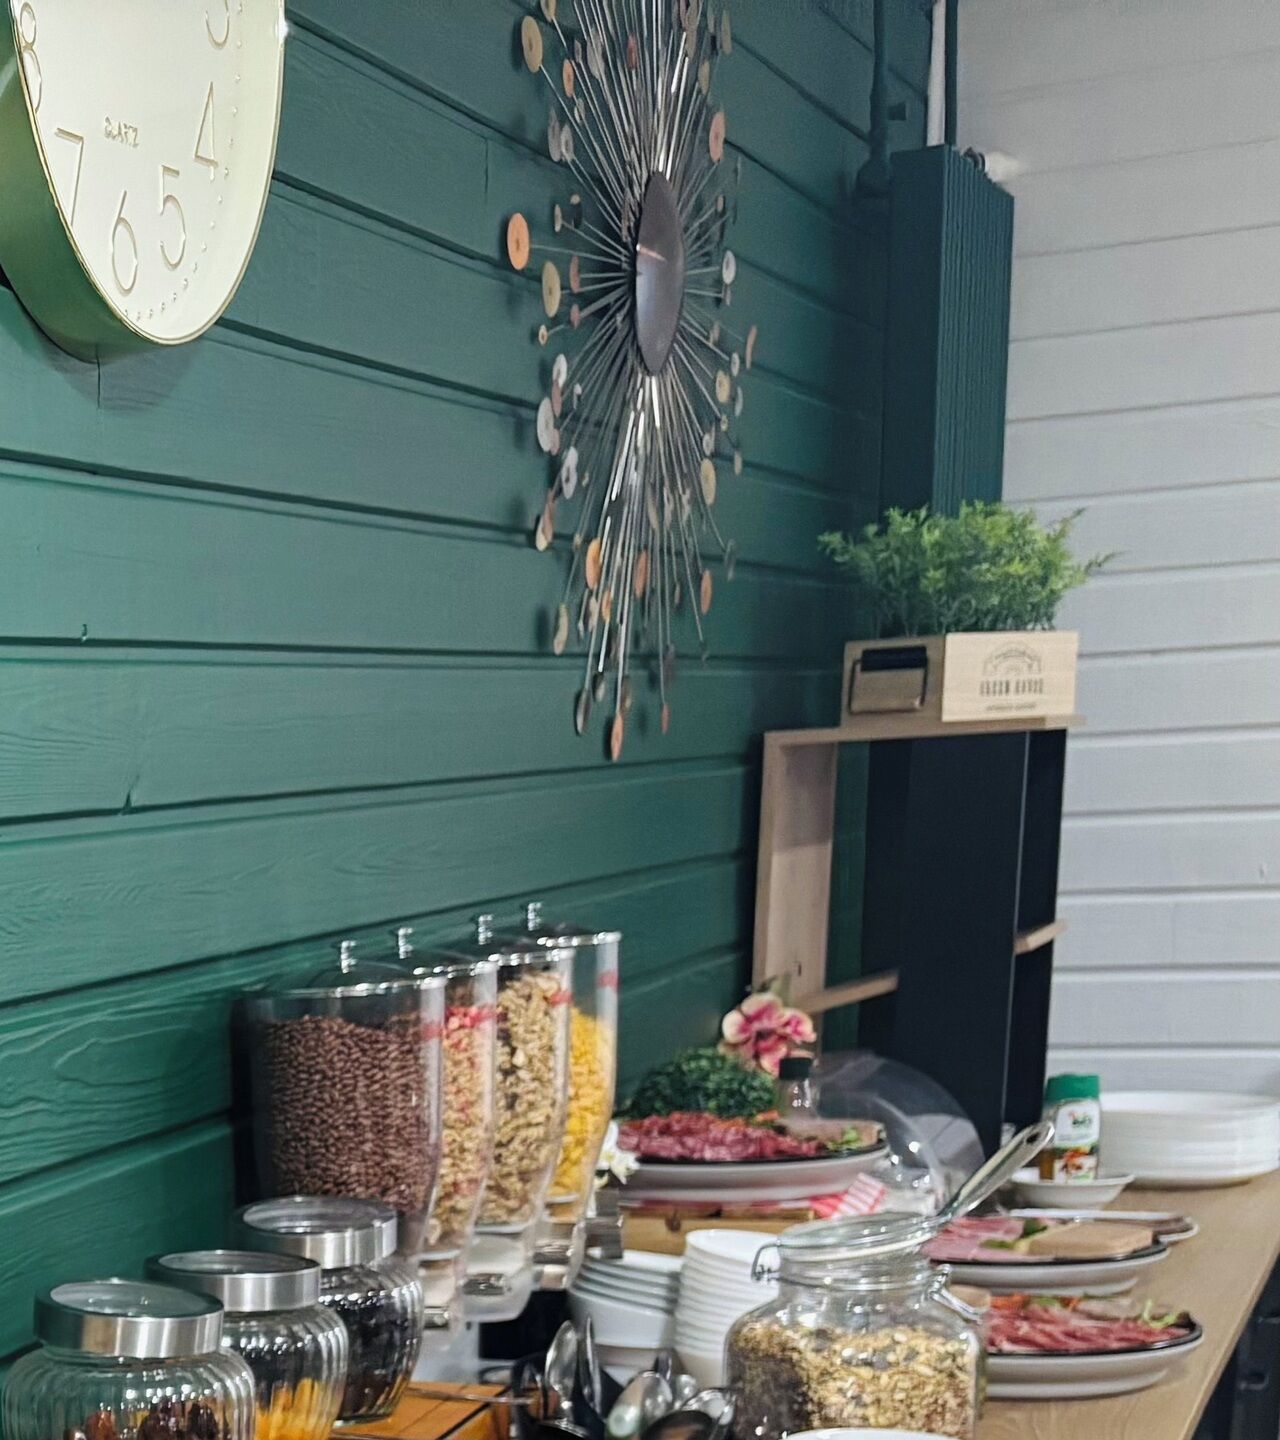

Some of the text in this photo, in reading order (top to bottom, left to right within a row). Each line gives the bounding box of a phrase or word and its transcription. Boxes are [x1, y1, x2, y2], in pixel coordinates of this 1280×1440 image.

[54, 128, 84, 227] 7
[194, 82, 219, 181] 4
[111, 190, 138, 293] 6
[159, 164, 186, 270] 5
